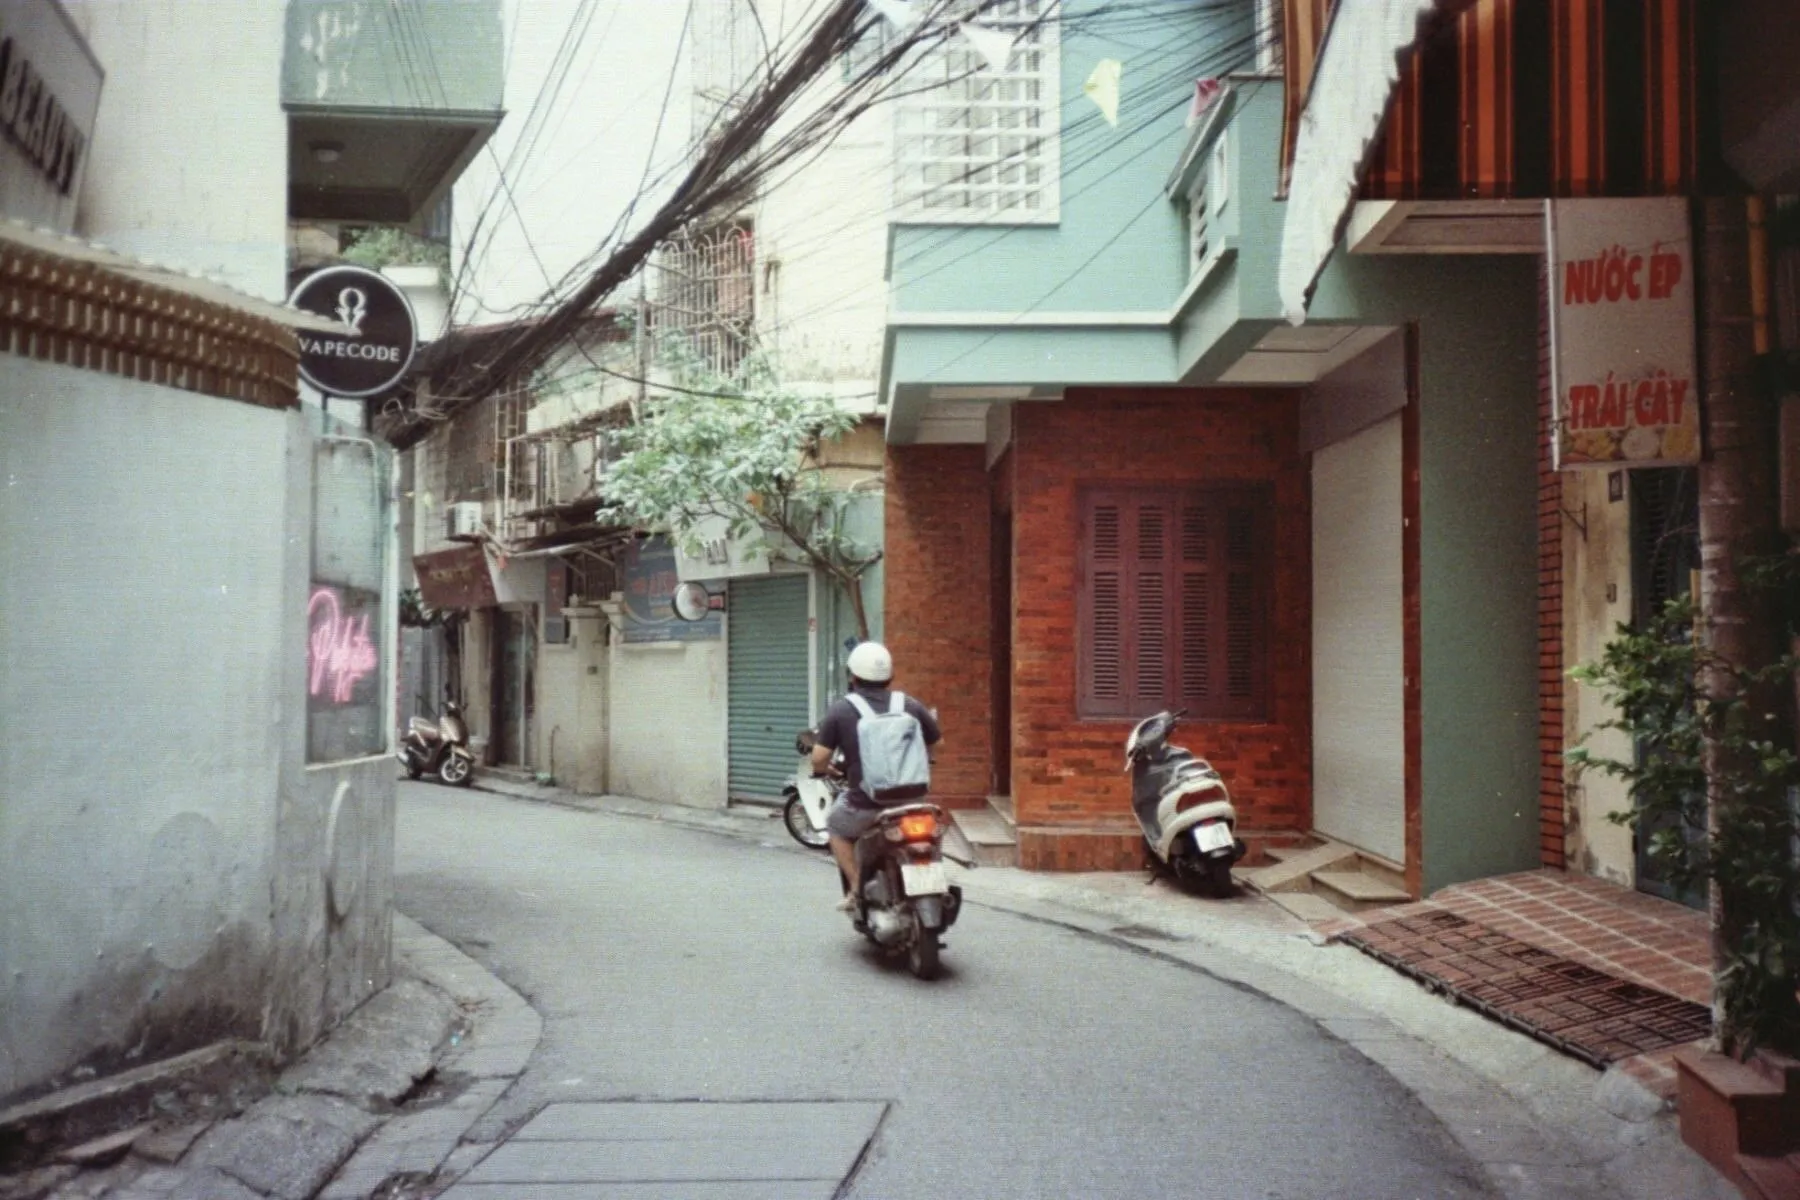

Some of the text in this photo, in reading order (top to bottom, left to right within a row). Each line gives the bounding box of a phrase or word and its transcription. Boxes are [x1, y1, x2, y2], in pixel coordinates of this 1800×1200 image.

[1564, 239, 1683, 305] NƯỚC ÉP
[298, 338, 401, 362] VAPECODE
[1569, 369, 1689, 430] TRÁI CÂY
